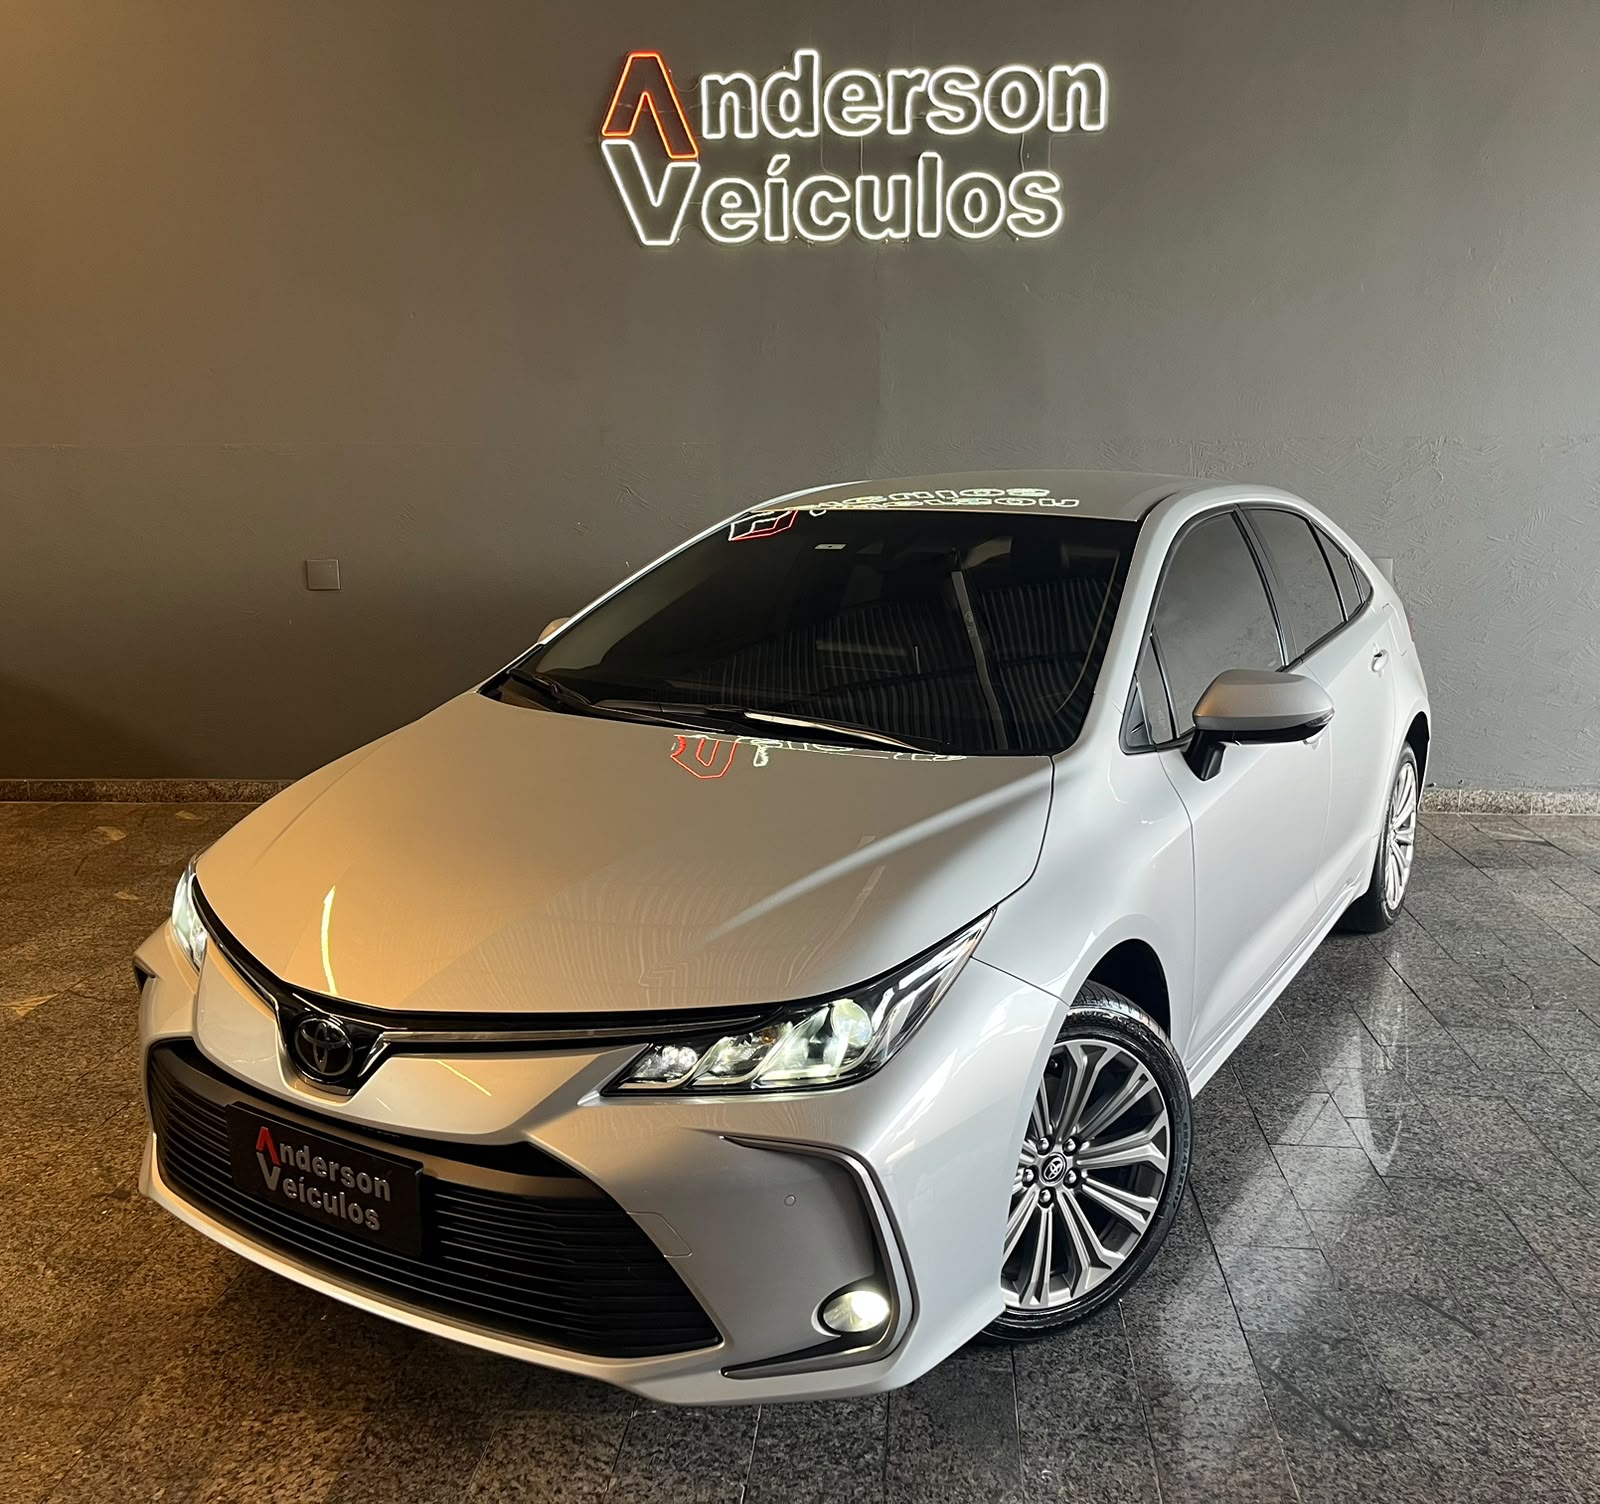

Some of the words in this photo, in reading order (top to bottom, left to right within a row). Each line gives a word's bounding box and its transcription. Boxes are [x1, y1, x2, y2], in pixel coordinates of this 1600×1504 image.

[601, 48, 1108, 160] Anderson
[601, 139, 1063, 246] Veículos
[256, 1126, 391, 1201] Anderson
[256, 1151, 381, 1231] Veículos
